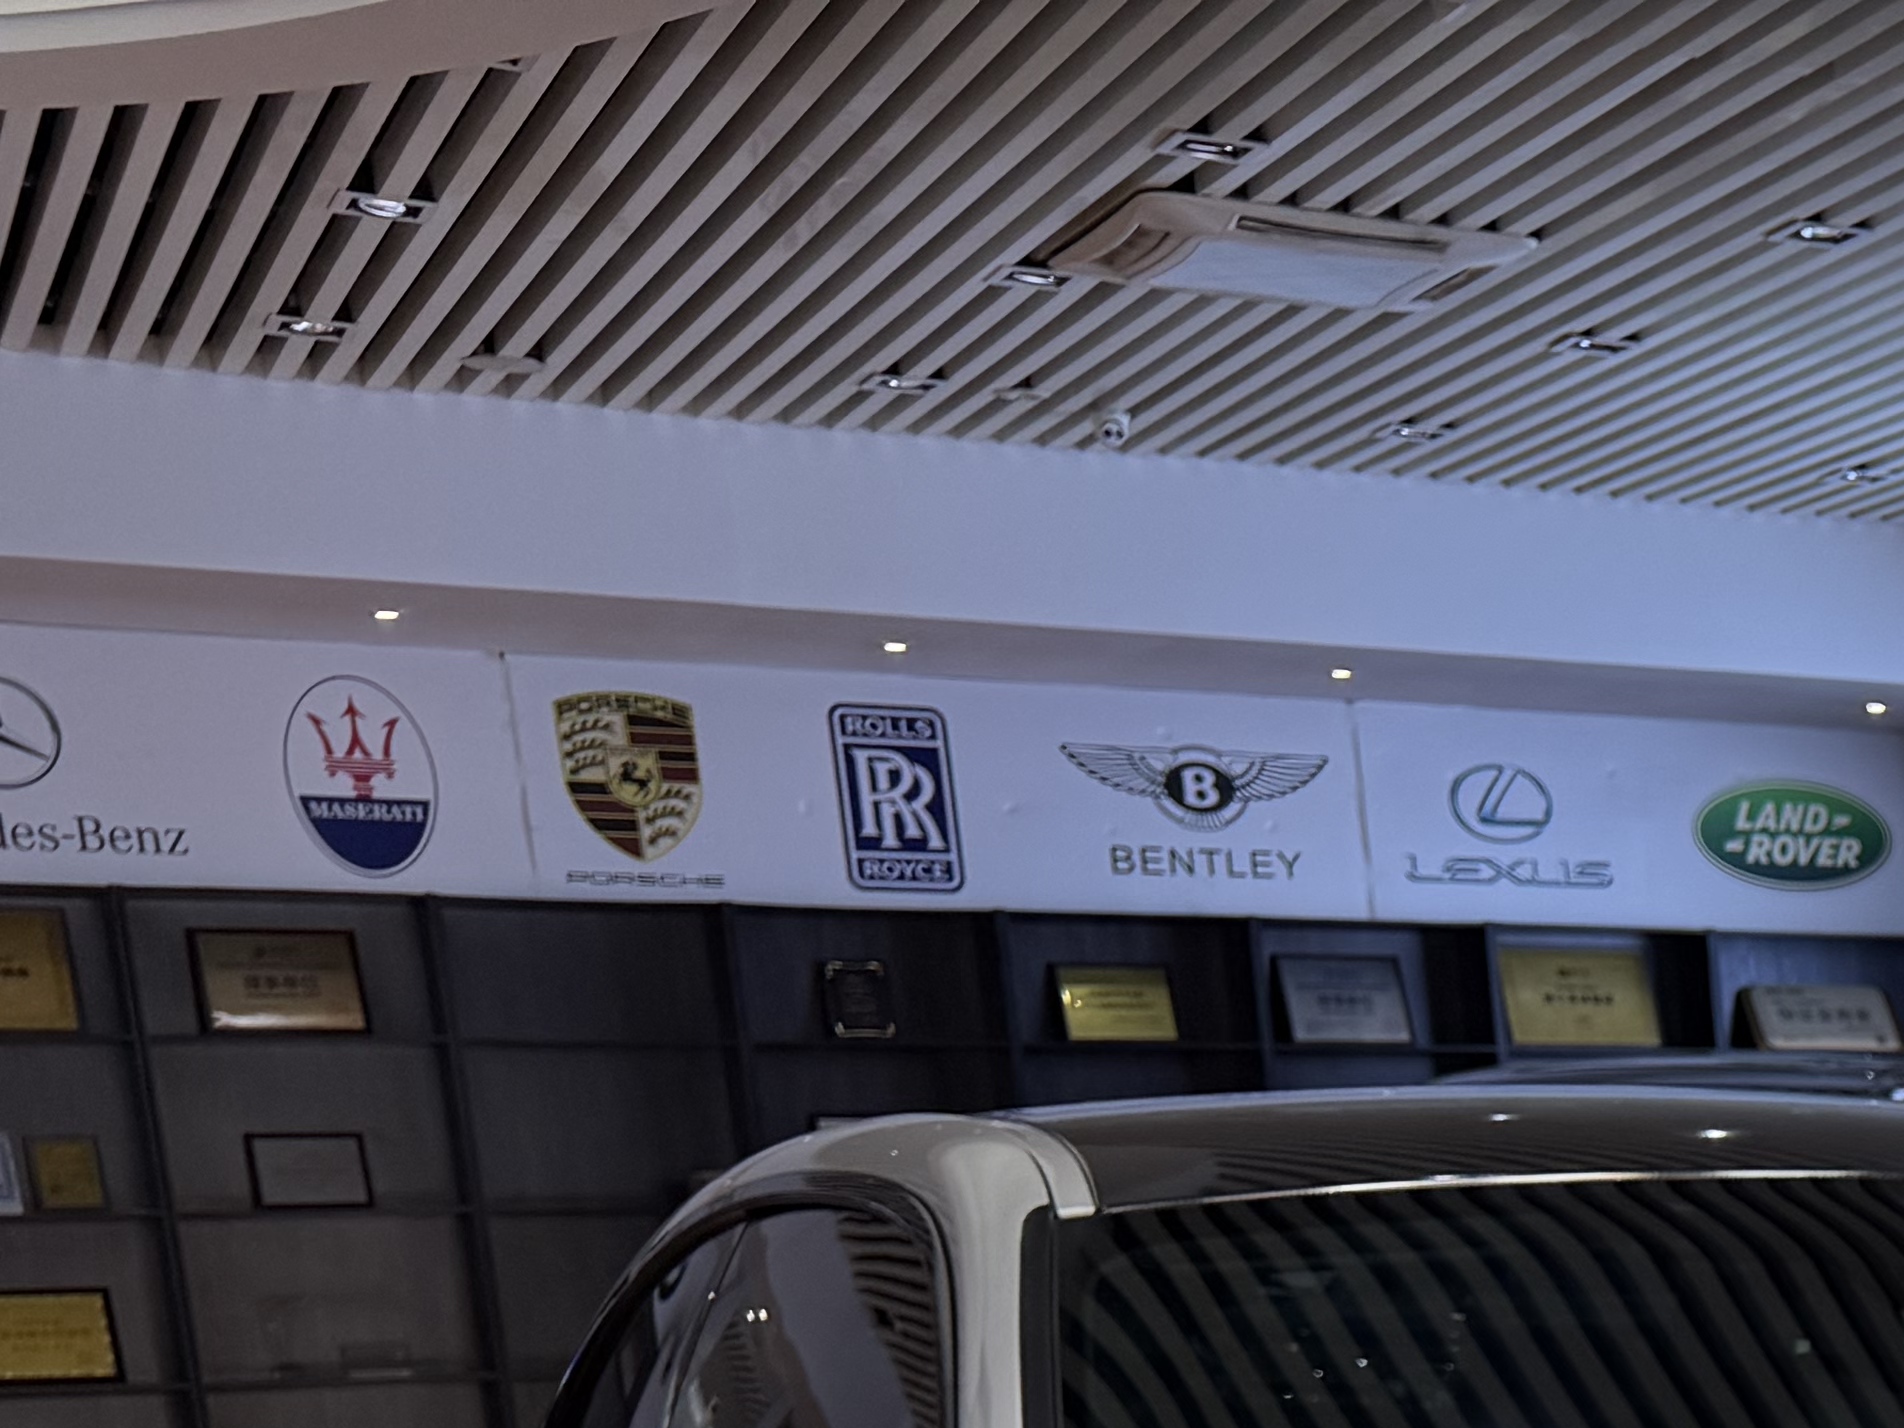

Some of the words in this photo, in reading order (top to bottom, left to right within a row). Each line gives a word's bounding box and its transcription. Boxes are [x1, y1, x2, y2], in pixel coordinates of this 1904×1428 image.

[842, 714, 933, 740] ROLLS
[307, 799, 426, 824] MASERATI
[1733, 801, 1828, 834] LAND
[0, 811, 190, 856] es-Benz
[1108, 843, 1301, 881] BENTLEY
[1746, 835, 1863, 870] ROVER
[566, 870, 726, 890] PORSCHE
[862, 858, 951, 884] ROYCE
[1404, 851, 1615, 889] LEXUS
